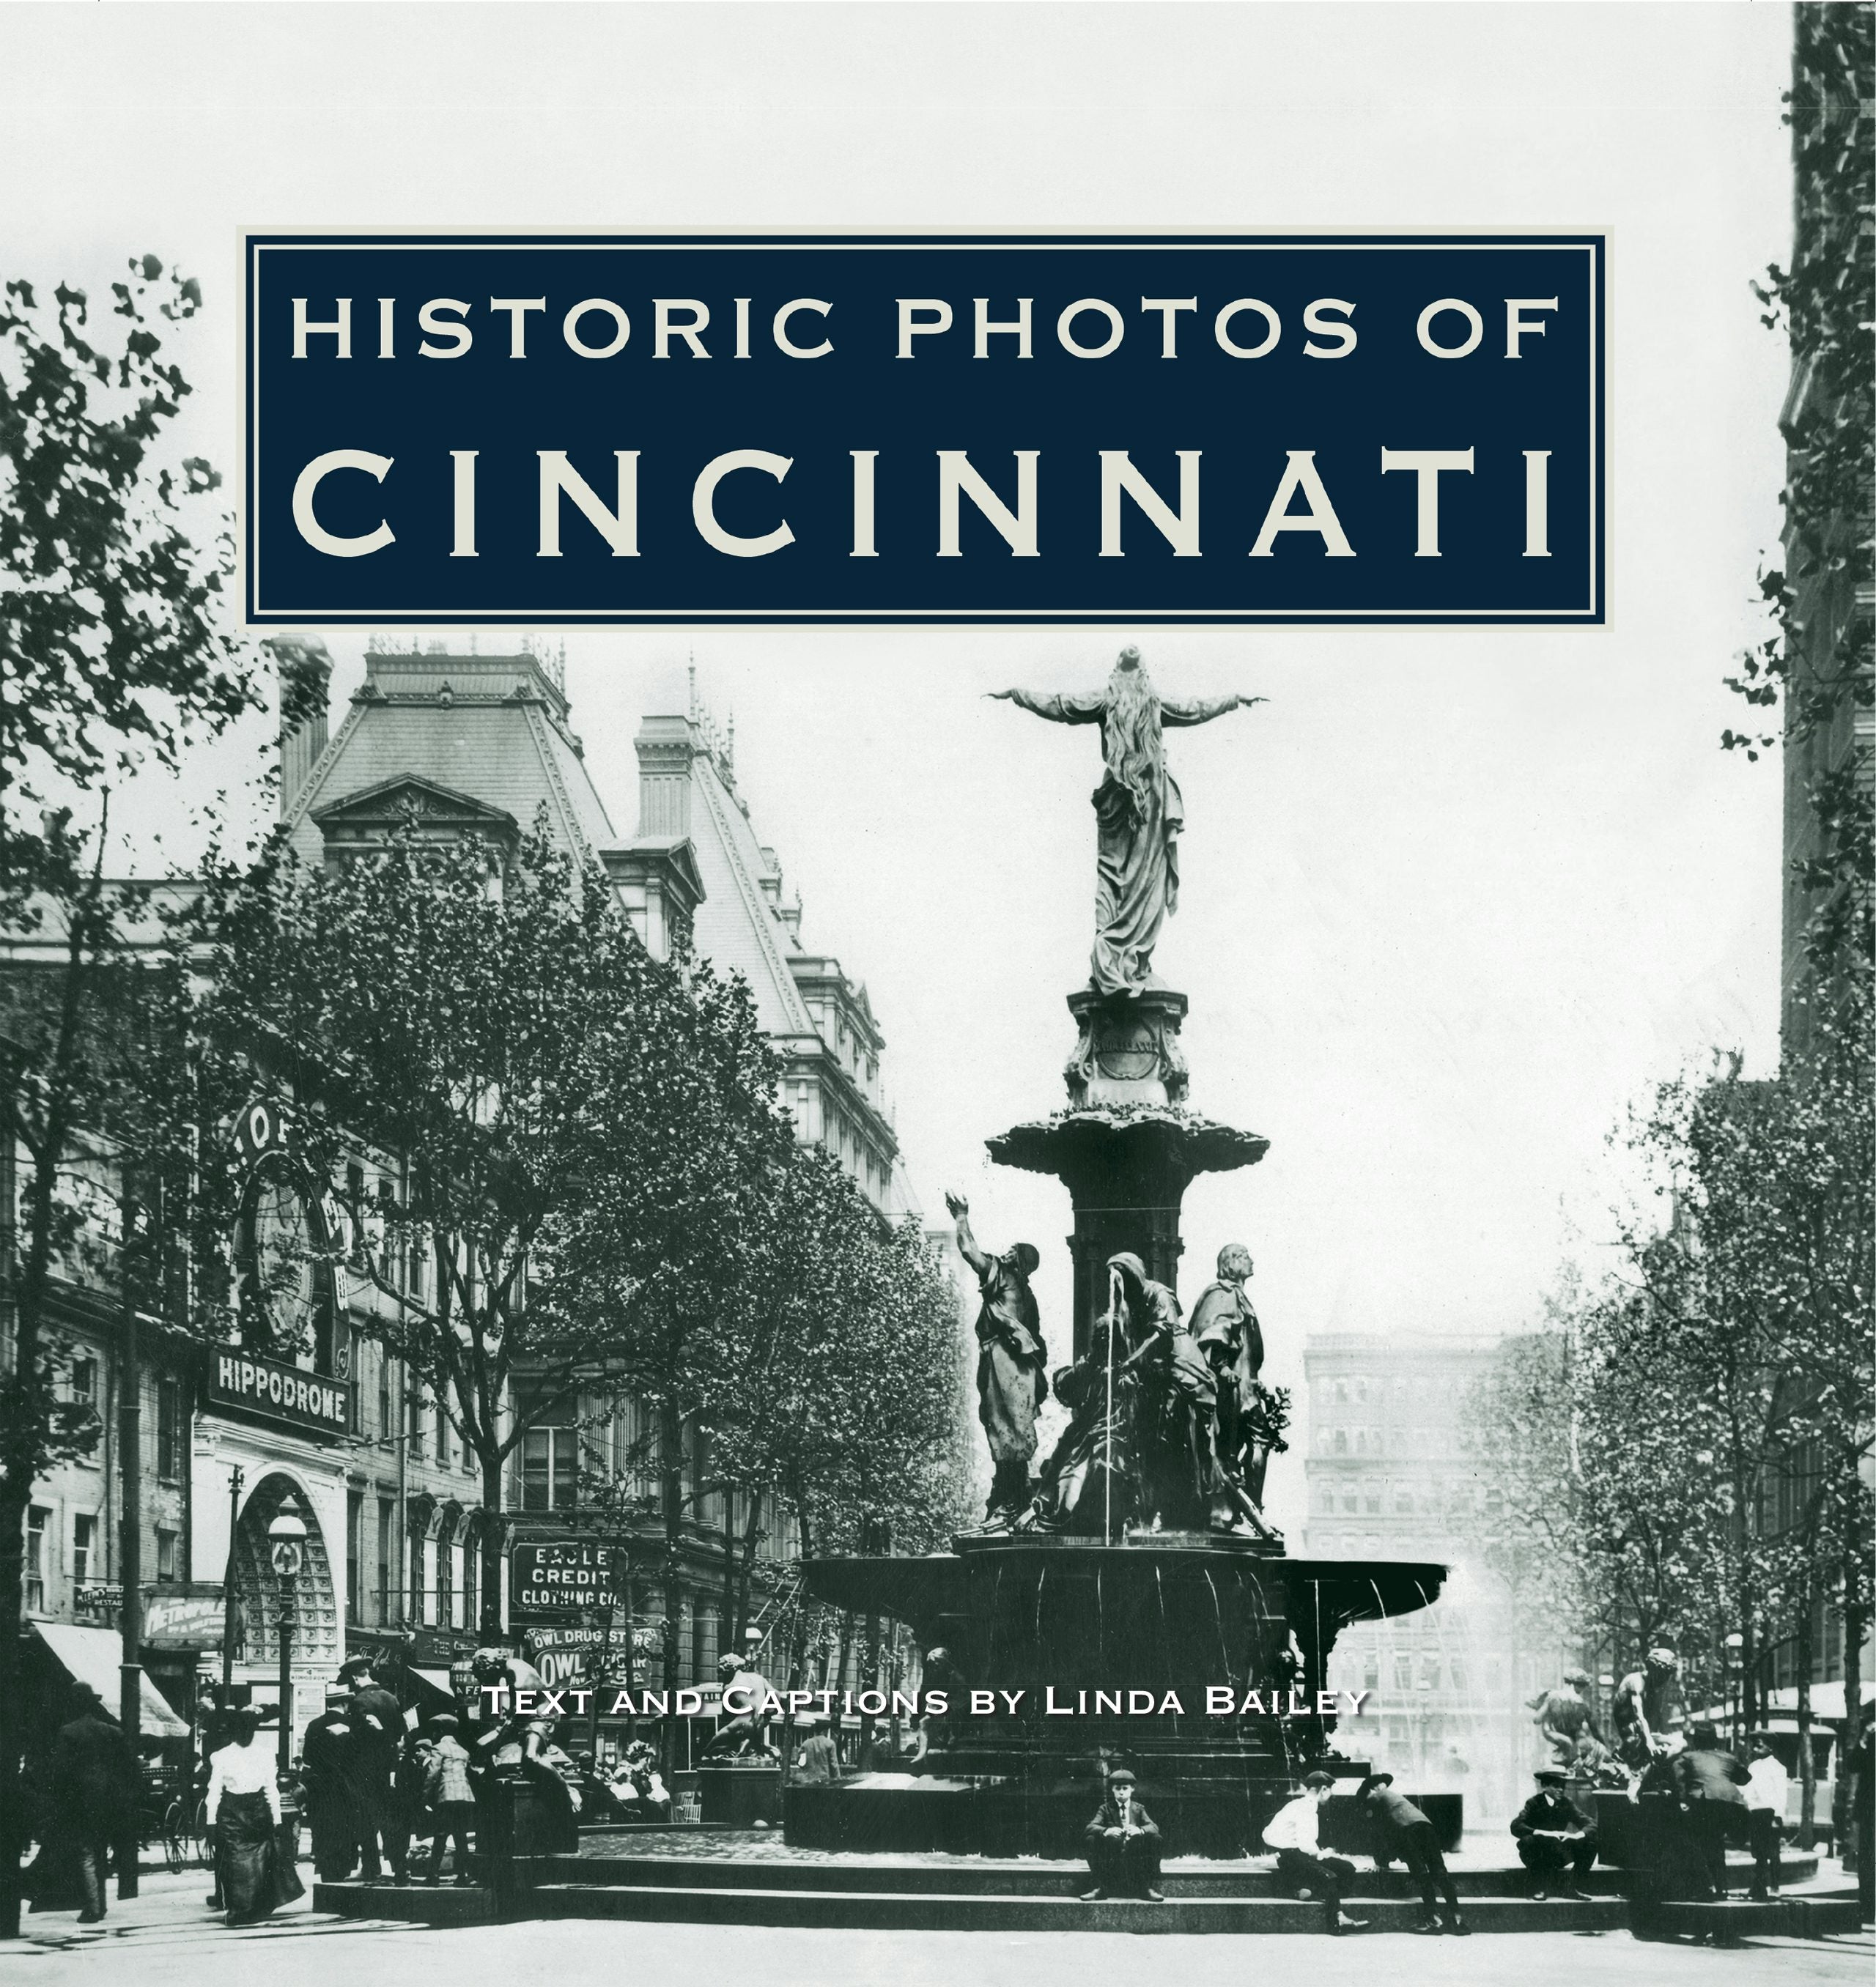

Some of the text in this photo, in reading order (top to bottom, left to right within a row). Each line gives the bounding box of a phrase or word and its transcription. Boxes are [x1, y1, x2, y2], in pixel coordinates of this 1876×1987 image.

[219, 1356, 346, 1424] HIPPODROME
[532, 1568, 610, 1585] CREDIT
[534, 1629, 652, 1649] OWL DRUG STRE
[541, 1653, 586, 1688] OWL
